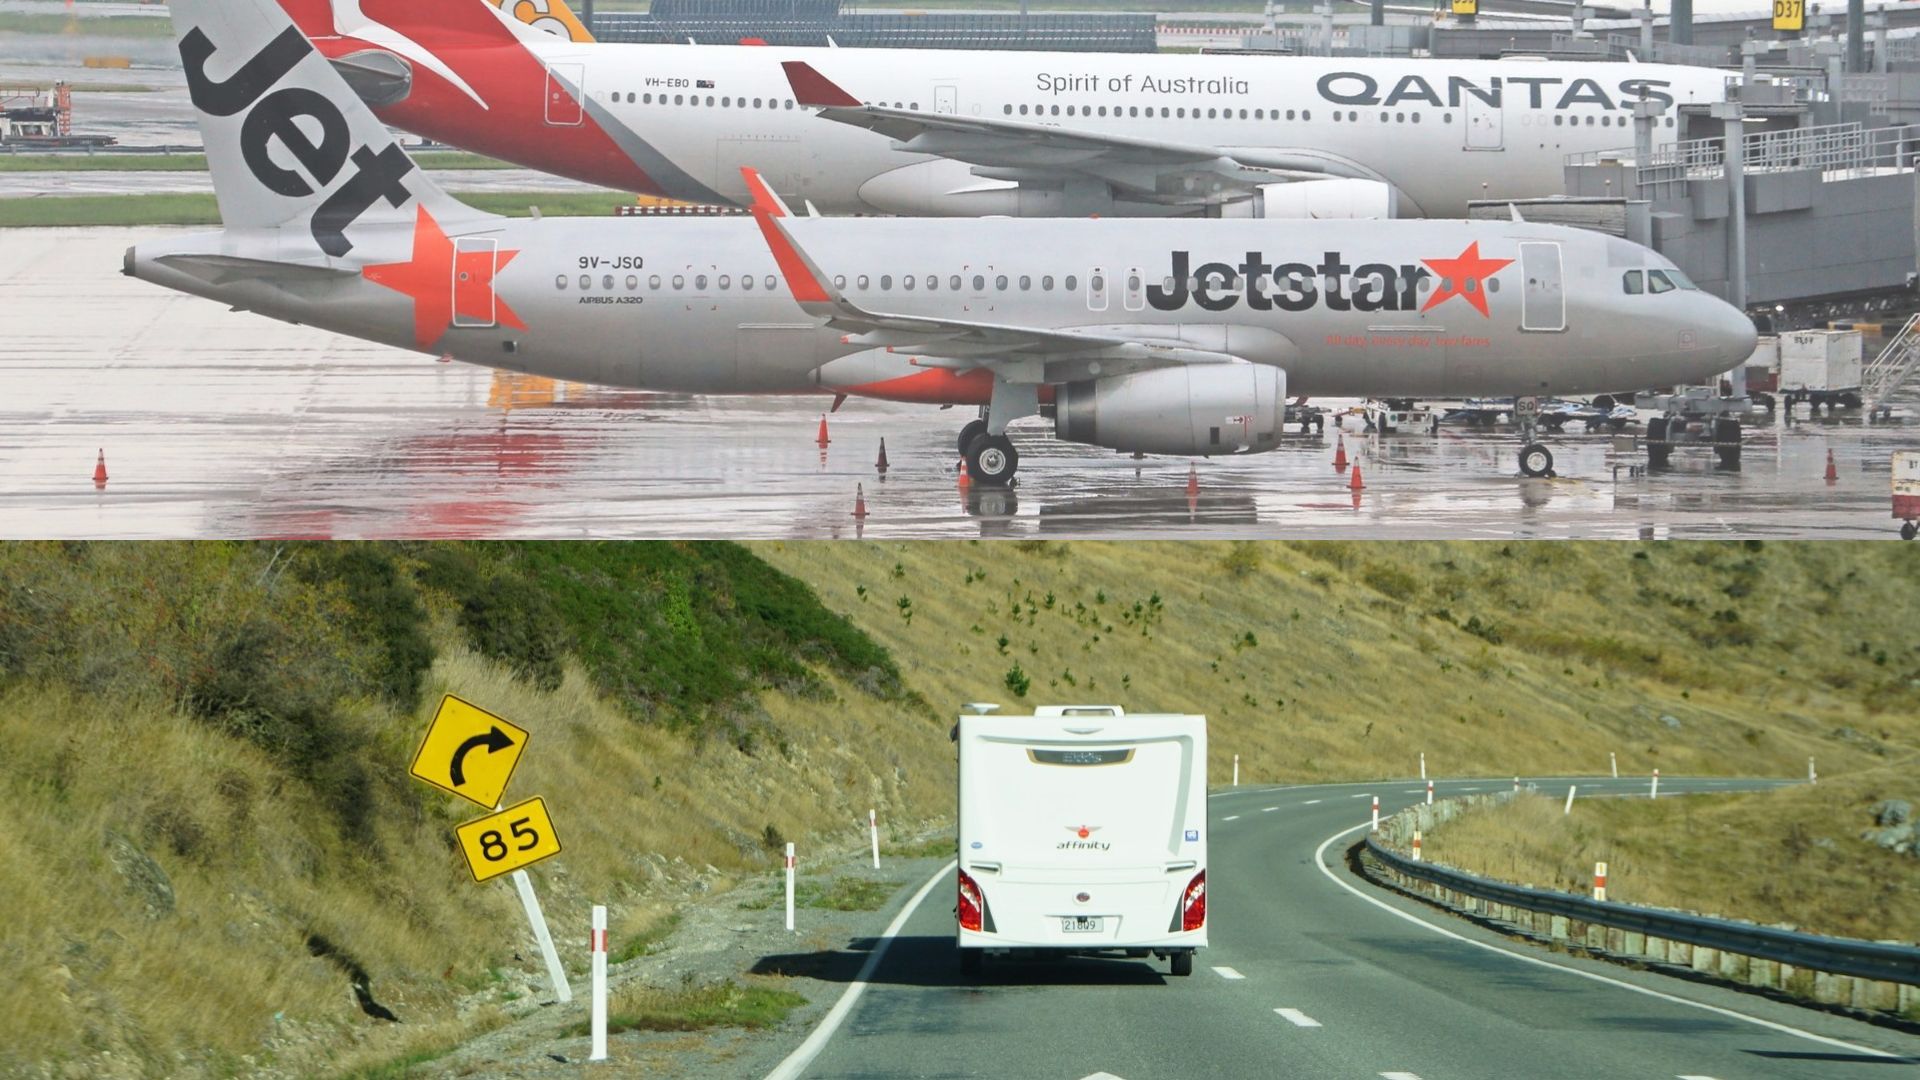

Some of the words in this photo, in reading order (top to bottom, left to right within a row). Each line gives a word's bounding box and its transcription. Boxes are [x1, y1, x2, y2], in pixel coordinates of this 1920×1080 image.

[1775, 1, 1801, 18] D37
[645, 77, 690, 88] VH-EBO
[1036, 72, 1100, 96] Spirit
[1107, 74, 1133, 92] of
[1140, 75, 1249, 95] Australia
[1316, 71, 1674, 111] QANTAS
[178, 23, 415, 258] Jet
[578, 256, 644, 270] 9V-JSQ
[1146, 250, 1432, 312] Jetstar
[578, 296, 614, 304] AIRBUS
[615, 296, 644, 304] A320
[479, 816, 540, 862] 85
[1056, 841, 1111, 851] affinity
